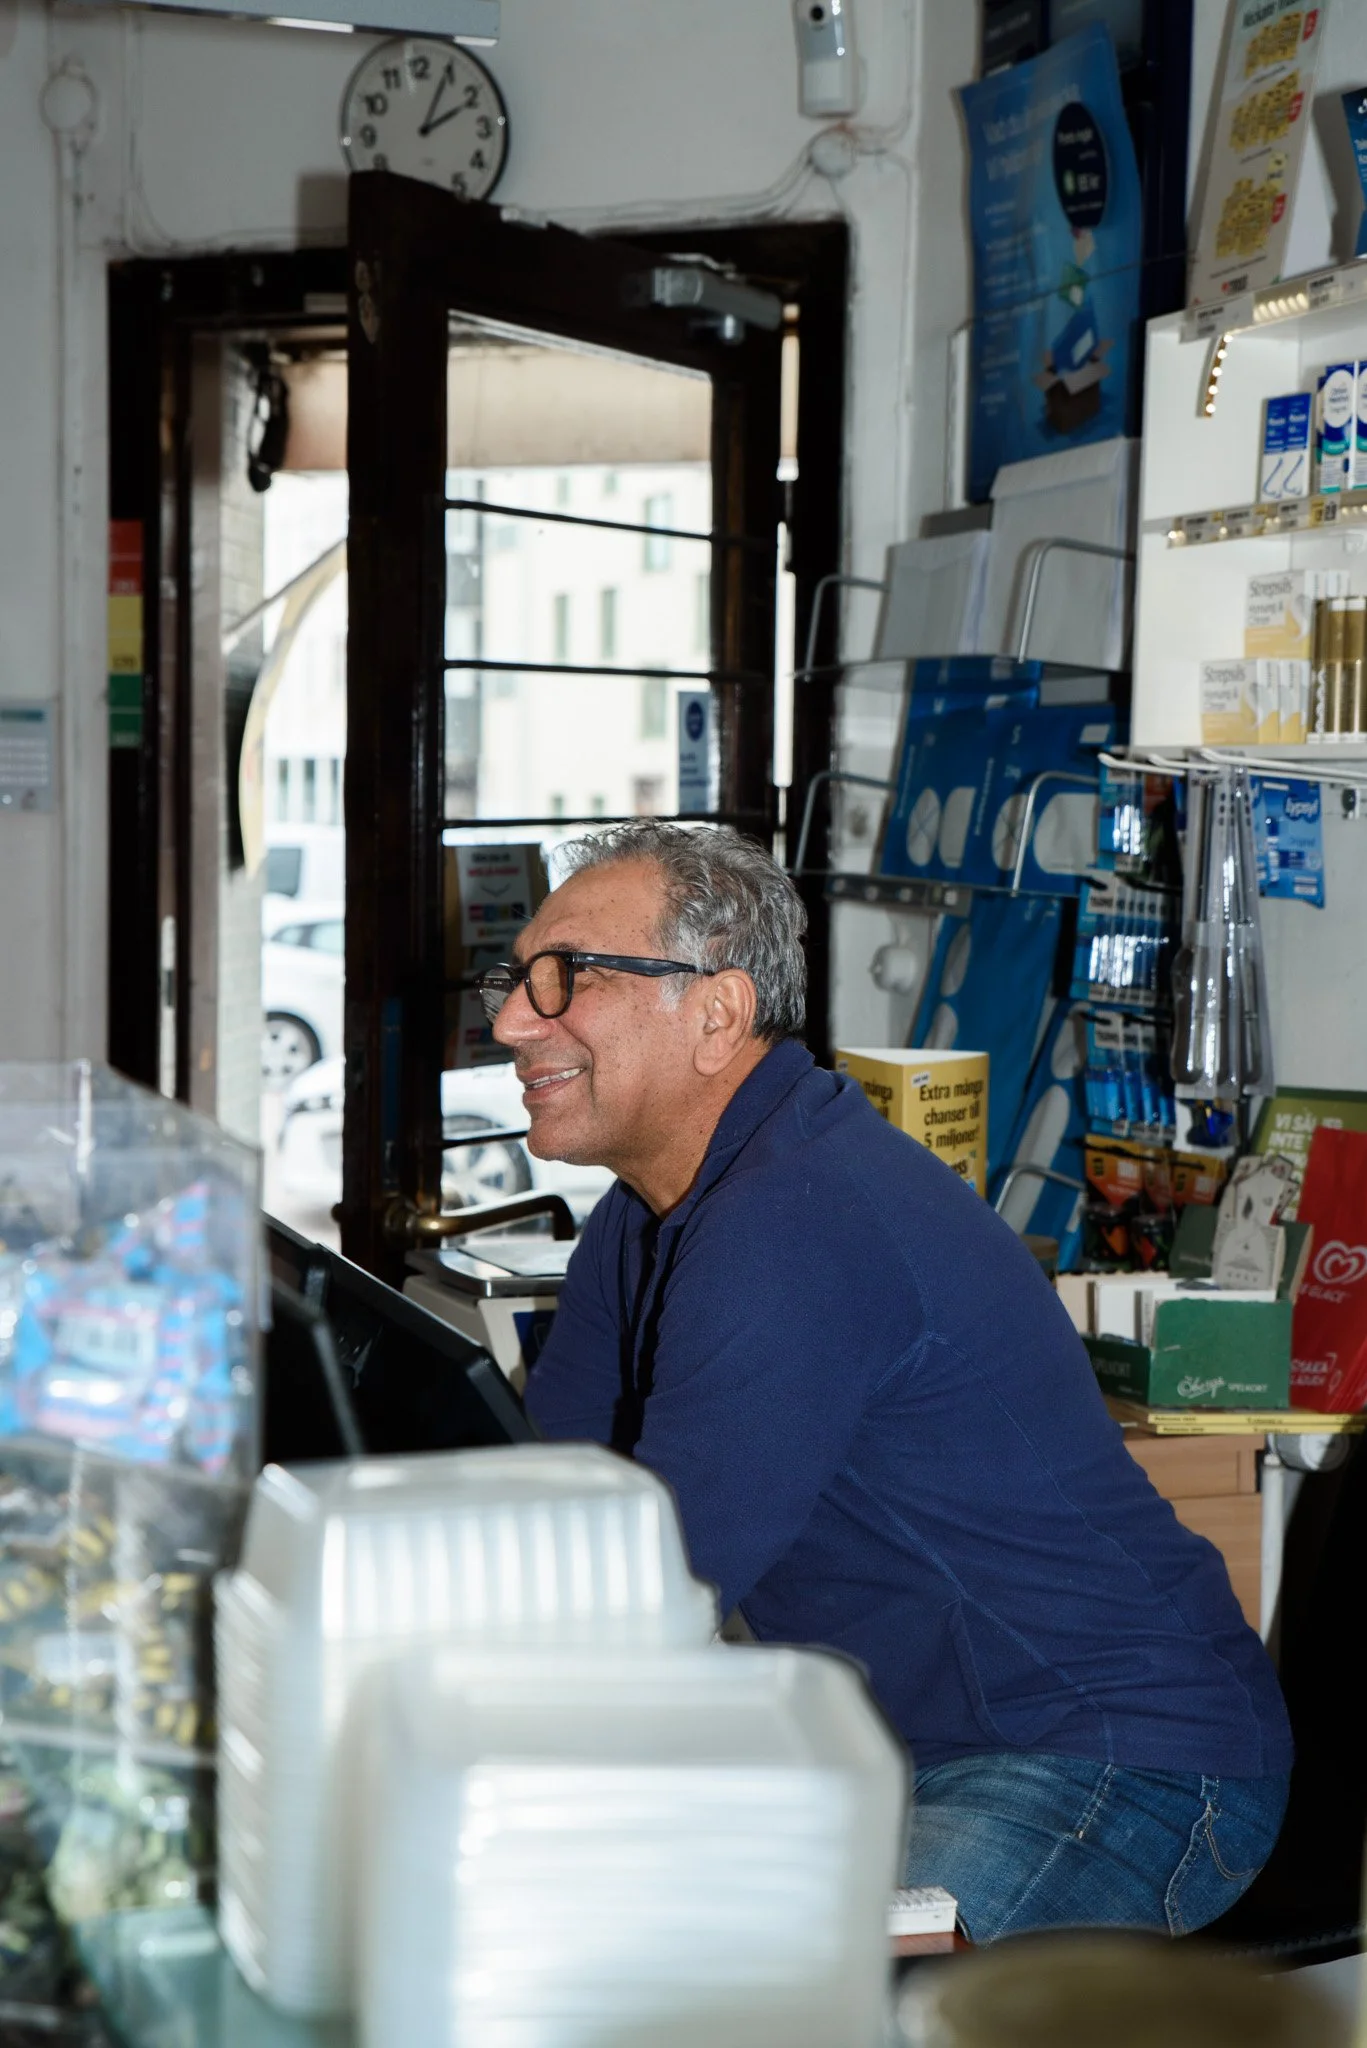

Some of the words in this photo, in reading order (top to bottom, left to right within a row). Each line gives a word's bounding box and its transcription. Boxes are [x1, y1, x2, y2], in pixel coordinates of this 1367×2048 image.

[382, 68, 401, 89] 11
[410, 56, 429, 79] 12
[365, 93, 387, 115] 10
[464, 85, 477, 109] 2
[360, 125, 376, 148] 9
[477, 116, 491, 139] 3
[470, 150, 484, 170] 4
[452, 172, 466, 201] 5
[1250, 576, 1292, 598] Strepsils
[919, 1084, 950, 1102] Extra
[924, 1107, 967, 1126] chanser
[969, 1099, 980, 1119] till
[1275, 1113, 1291, 1130] VI
[924, 1131, 932, 1148] 5
[1269, 1131, 1304, 1151] INTE
